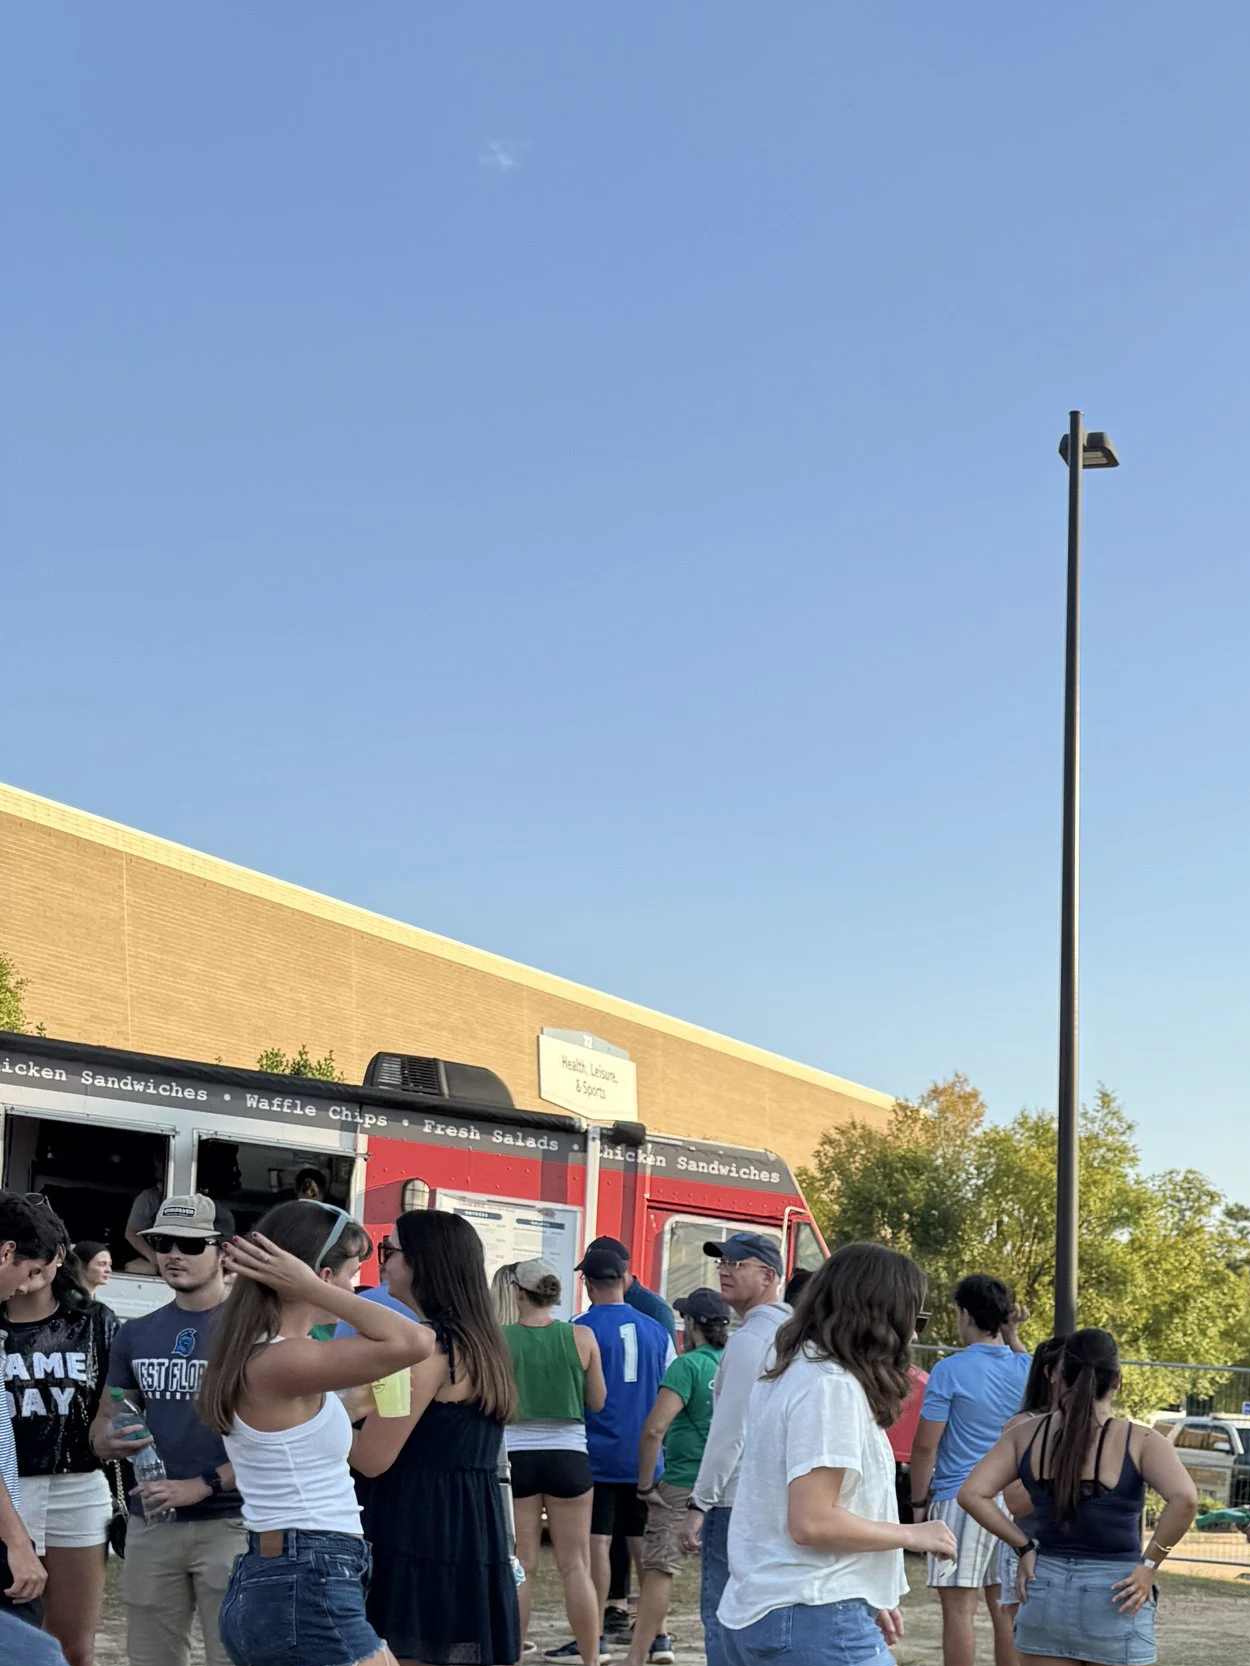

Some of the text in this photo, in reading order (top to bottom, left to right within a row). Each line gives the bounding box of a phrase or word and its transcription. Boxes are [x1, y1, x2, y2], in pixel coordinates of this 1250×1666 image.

[562, 1055, 618, 1084] Health, Leisure,
[576, 1079, 606, 1099] & Sports
[0, 1058, 780, 1184] icken Sandwiches Waffle Chips Fresh Salads hicken Sandwiches
[4, 1351, 87, 1380] AME
[619, 1323, 638, 1383] 1
